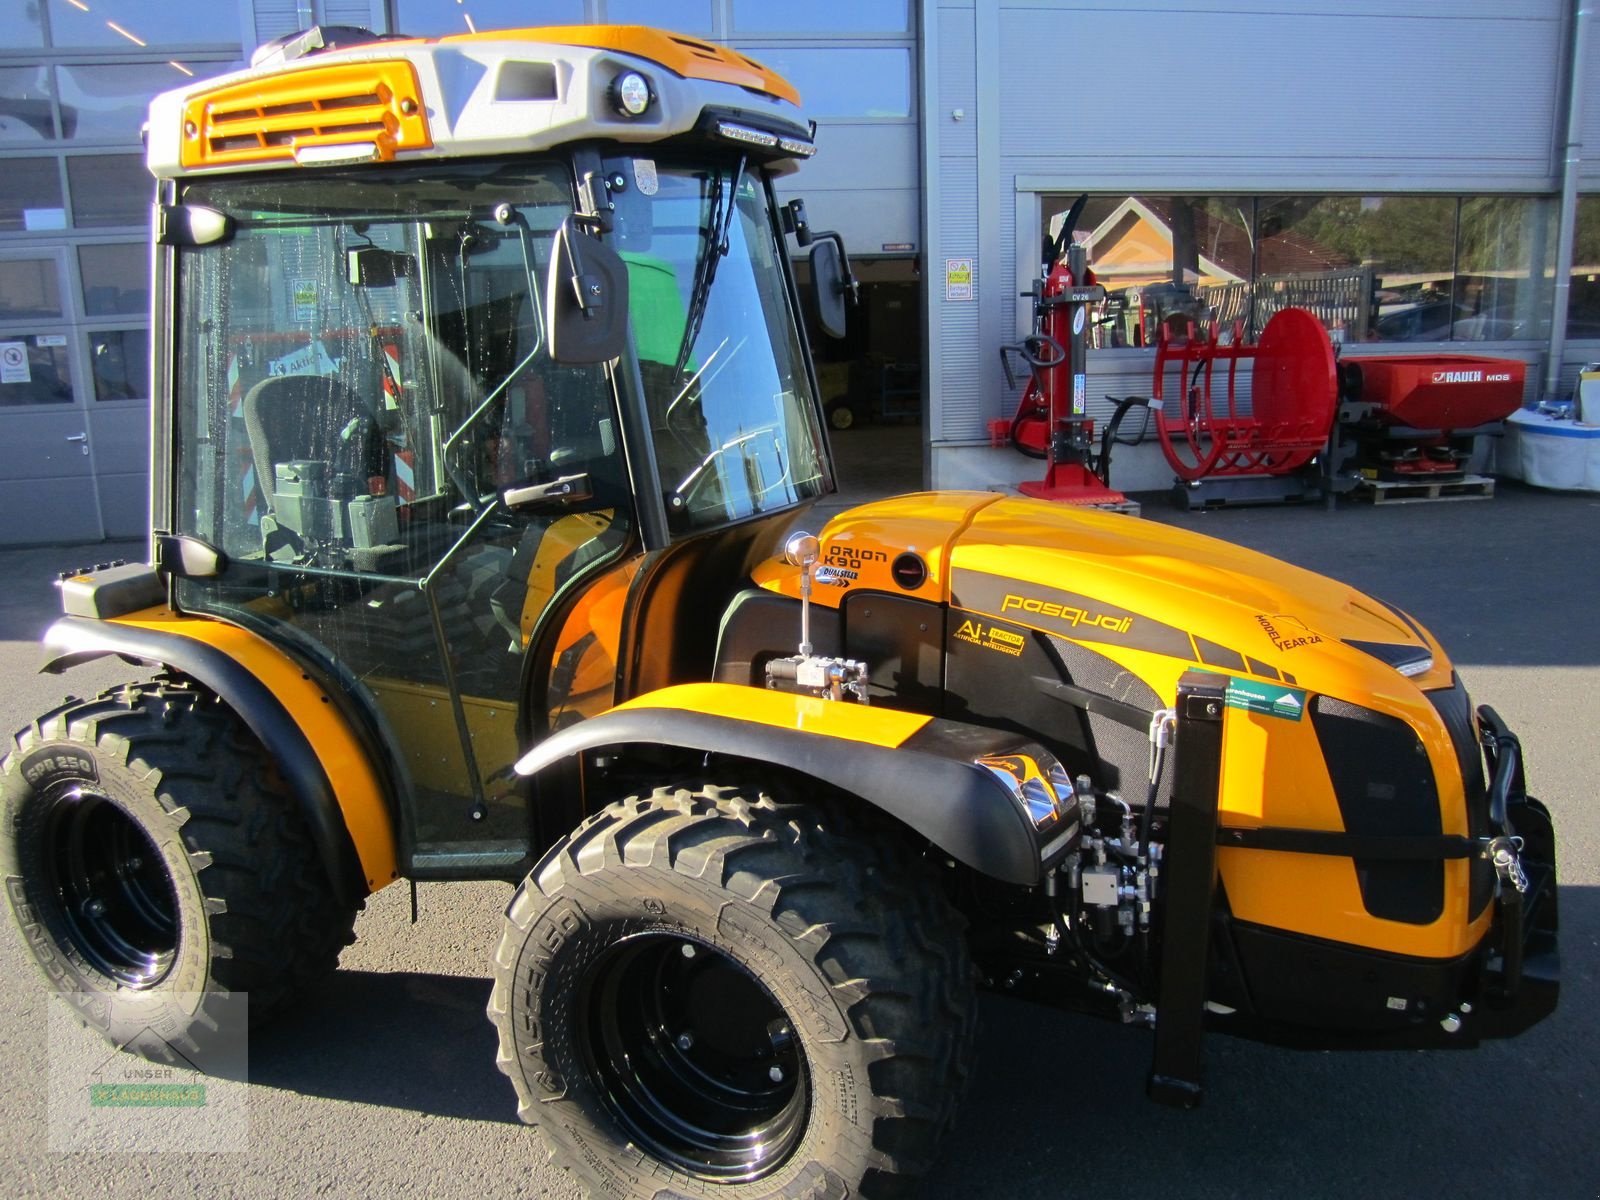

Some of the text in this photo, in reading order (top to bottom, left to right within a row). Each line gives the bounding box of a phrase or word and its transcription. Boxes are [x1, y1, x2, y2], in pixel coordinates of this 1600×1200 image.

[1445, 371, 1511, 383] RAUCH MDS
[823, 555, 861, 569] K90
[830, 545, 888, 563] ORION
[1000, 594, 1134, 634] pasquali
[990, 629, 1022, 645] TRACTOR
[1254, 614, 1281, 645] MODEL
[953, 632, 1021, 657] ARTIFICIAL INTELLIGENCE
[1274, 635, 1324, 652] YEAR 24
[26, 756, 92, 783] SPR 250
[12, 881, 95, 1009] ASCENSO
[521, 906, 582, 1062] ASCENSO
